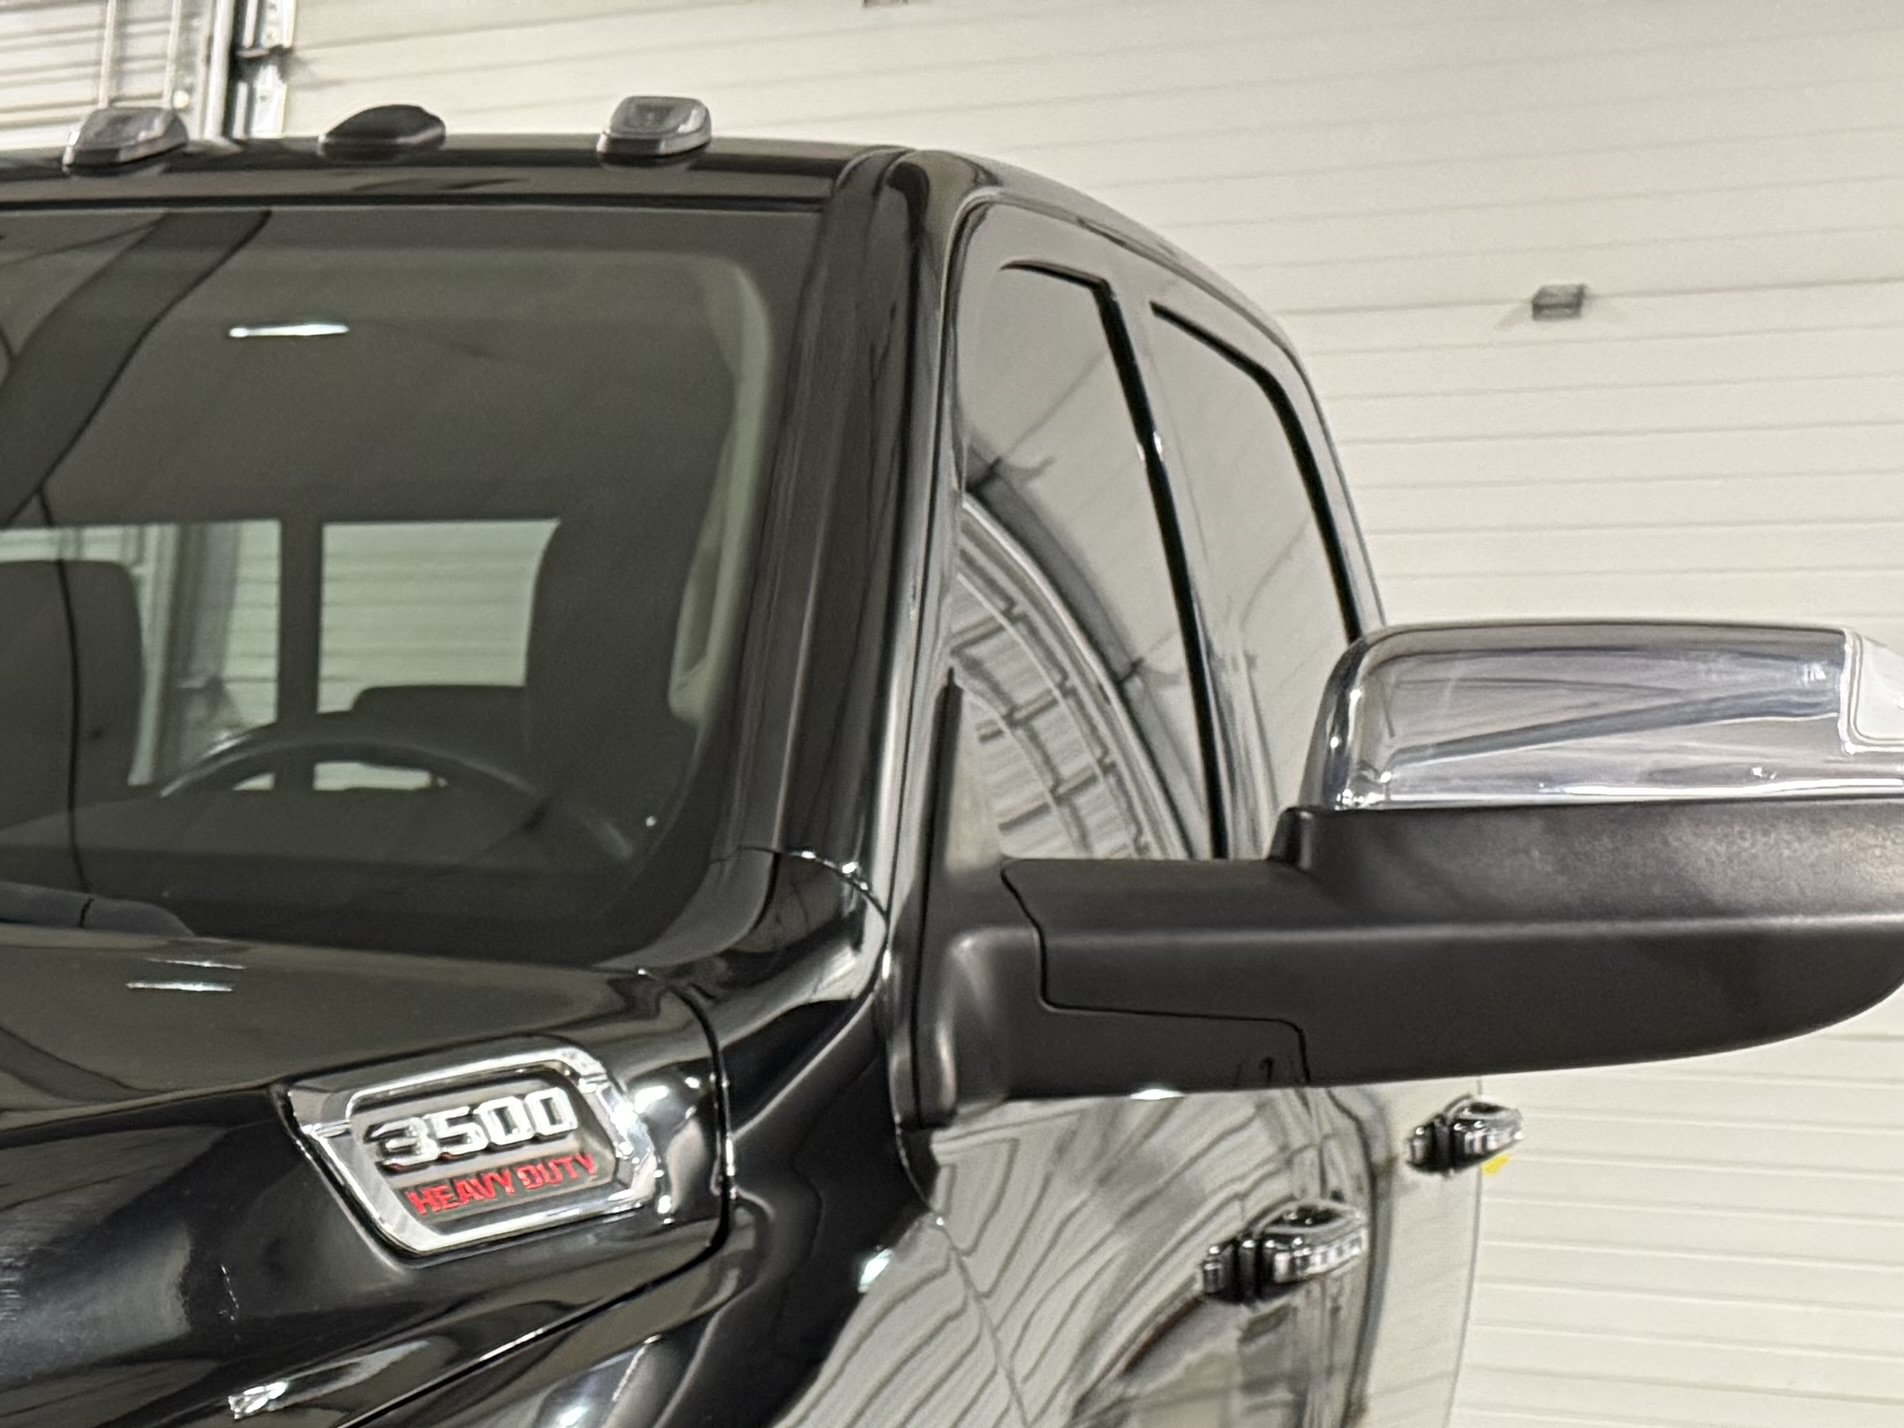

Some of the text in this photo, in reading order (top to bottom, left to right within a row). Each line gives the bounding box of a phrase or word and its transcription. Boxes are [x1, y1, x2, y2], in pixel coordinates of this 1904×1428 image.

[368, 1086, 578, 1166] 3500
[406, 1152, 598, 1217] HEAVY DUTY
